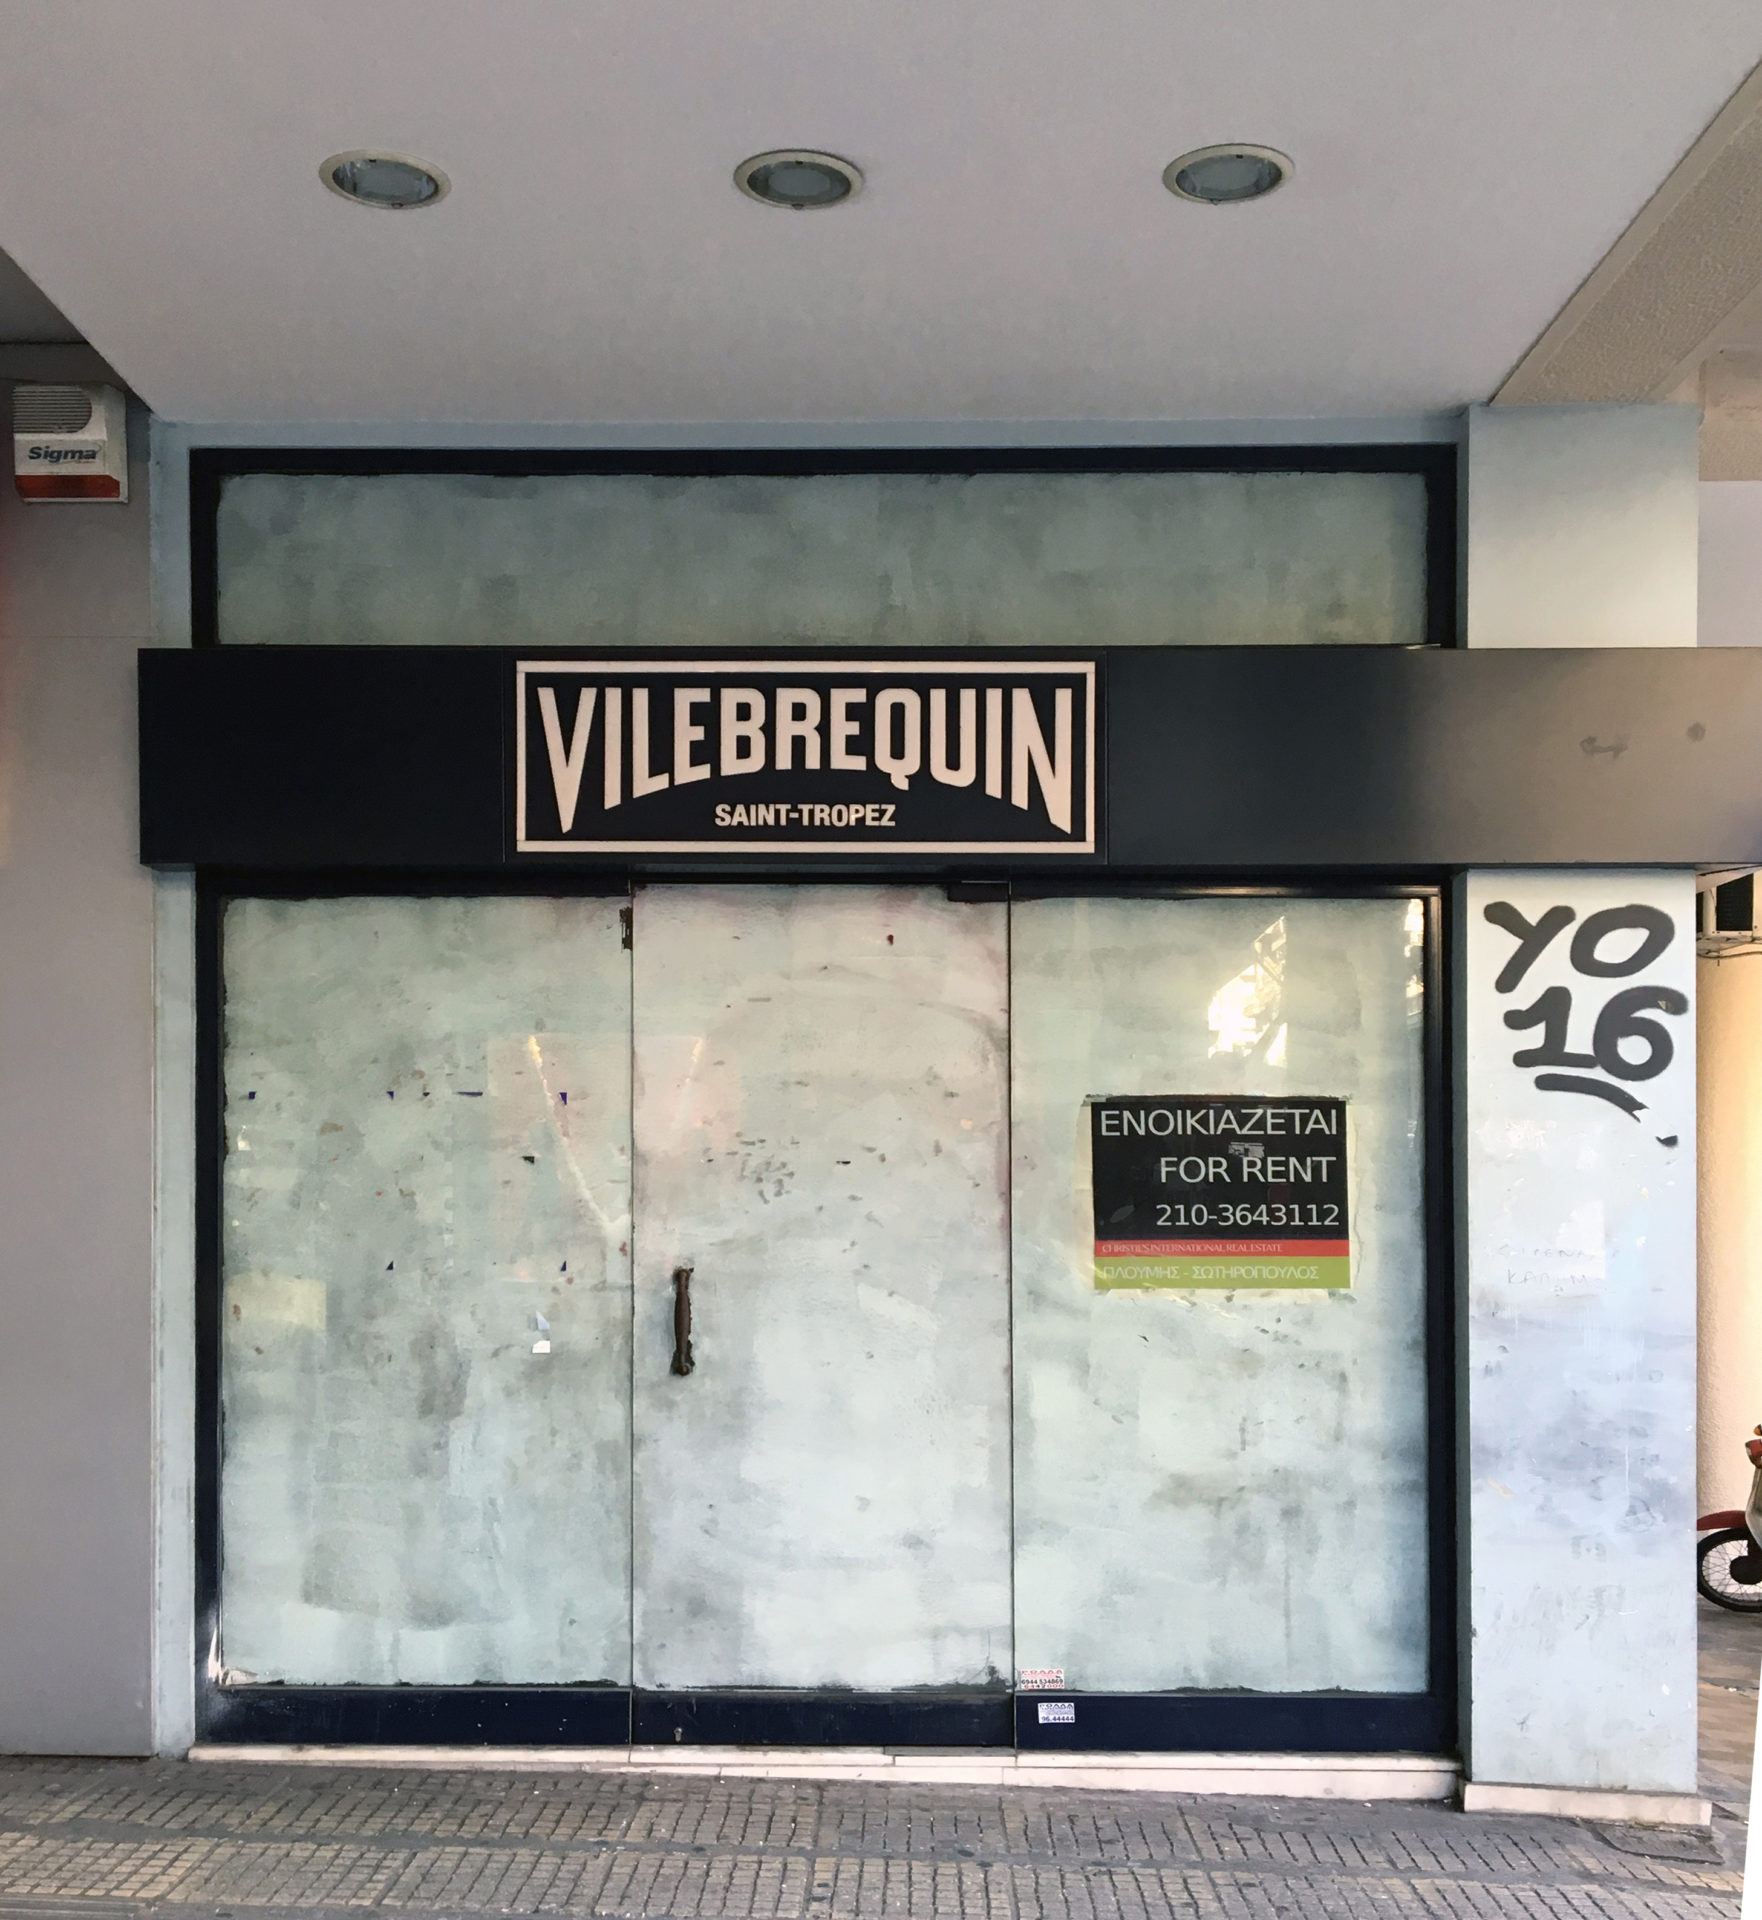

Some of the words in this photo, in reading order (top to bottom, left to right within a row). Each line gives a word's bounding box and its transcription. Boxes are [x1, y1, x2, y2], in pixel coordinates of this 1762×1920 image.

[28, 445, 97, 462] Sigma
[537, 687, 1073, 834] VILEBREQUIN
[714, 803, 897, 828] SAINT-TROPEZ
[1484, 901, 1675, 993] YO
[1503, 985, 1689, 1082] 16
[1101, 1109, 1338, 1136] ΕΝΟΙΚΙΑΖΕΤΑΙ
[1160, 1156, 1231, 1183] FOR
[1242, 1156, 1336, 1183] RENT
[1156, 1203, 1340, 1226] 210-3643112
[1150, 1243, 1226, 1253] INTERNATIONAL
[1226, 1243, 1250, 1253] REAL
[1251, 1243, 1283, 1253] ESTATE
[1103, 1265, 1180, 1280] ΠΛΟΥΜΗΣ
[1193, 1265, 1319, 1280] ΣΩΤΗΡΟΠΟΥΛΟΣ
